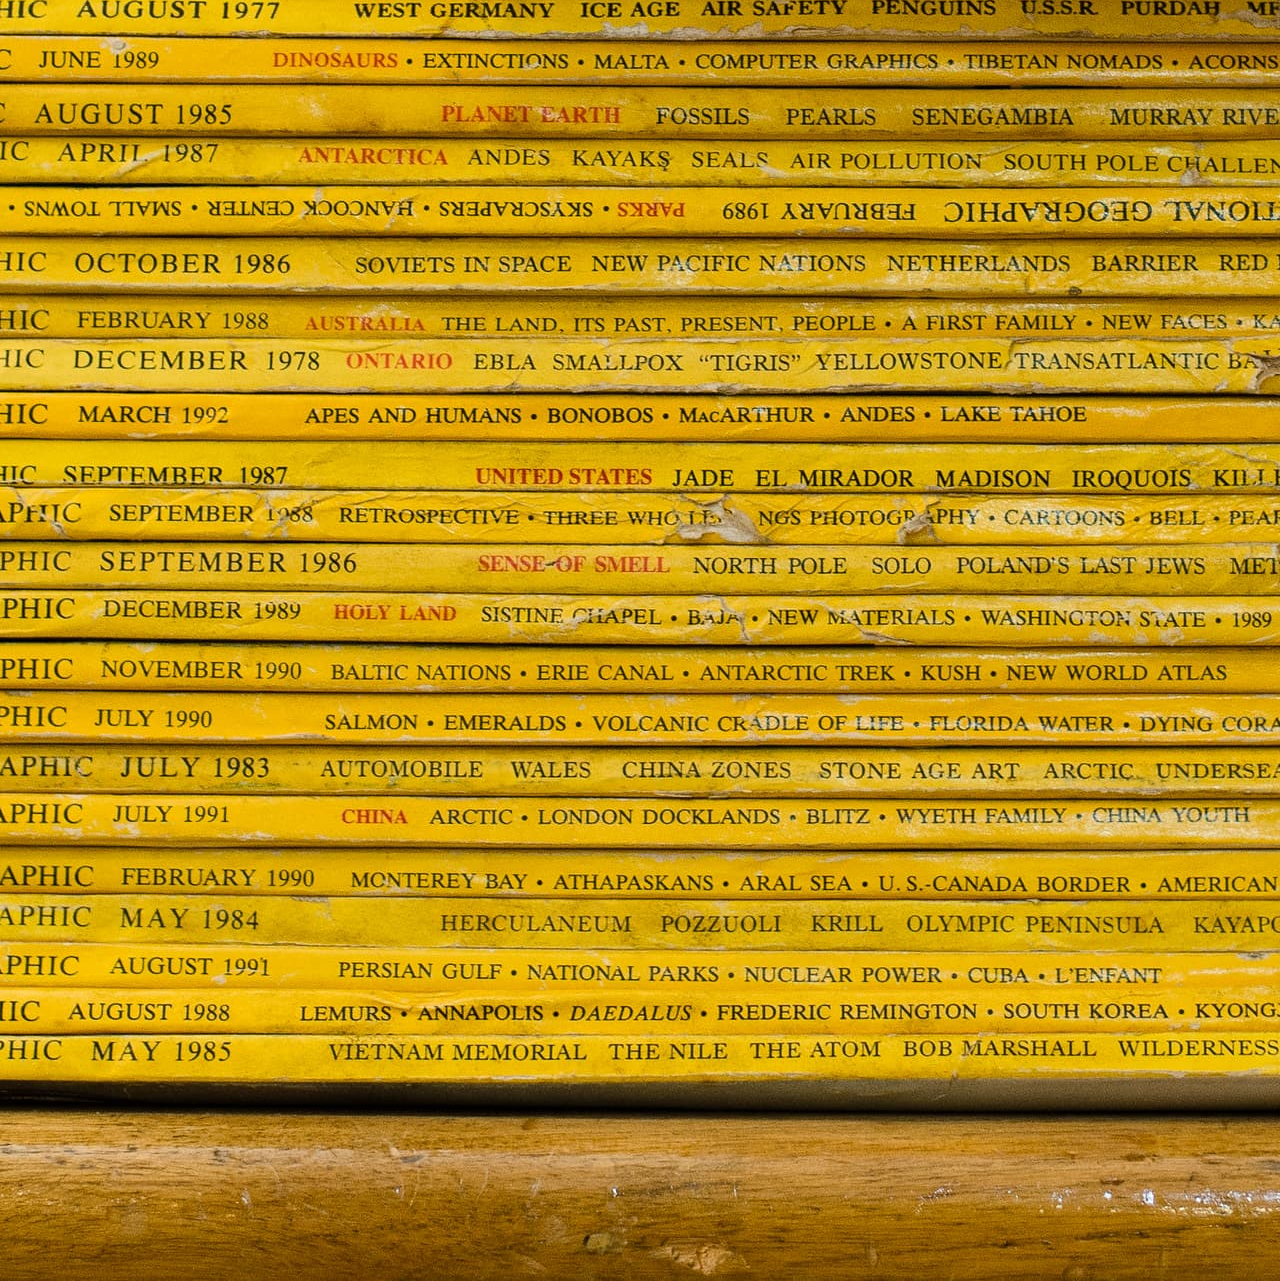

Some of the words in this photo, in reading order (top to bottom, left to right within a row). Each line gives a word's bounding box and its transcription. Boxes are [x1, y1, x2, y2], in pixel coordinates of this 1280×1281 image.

[38, 50, 101, 69] JUNE
[114, 51, 160, 69] 1989
[273, 52, 400, 68] DINOSAURS
[422, 53, 569, 70] EXTINCTIONS
[594, 54, 670, 70] MALTA
[694, 54, 819, 70] COMPUTER
[826, 53, 939, 69] GRAPHICS
[963, 54, 1059, 69] TIBETAN
[1066, 54, 1164, 69] NOMADS
[1188, 54, 1280, 69] ACORNS
[78, 405, 172, 424] MARCH
[182, 406, 229, 424] 1992
[304, 408, 360, 423] APES
[367, 408, 417, 423] AND
[425, 408, 524, 423] HUMANS
[547, 407, 654, 423] BONOBOS
[840, 406, 916, 422] ANDES
[940, 406, 1002, 422] LAKE
[1009, 406, 1088, 422] TAHOE
[101, 660, 243, 679] NOVEMBER
[256, 662, 302, 679] 1990
[331, 664, 409, 681] BALTIC
[416, 664, 512, 681] NATIONS
[536, 664, 590, 681] ERIE
[597, 664, 674, 681] CANAL
[699, 664, 828, 682] ANTARCTIC
[834, 664, 896, 682] TREK
[921, 665, 981, 681] KUSH
[1006, 664, 1057, 681] NEW
[1065, 664, 1149, 681] WORLD
[1156, 664, 1228, 681] ATLAS
[109, 956, 214, 976] AUGUST
[225, 957, 269, 976] 1991
[338, 961, 433, 979] PERSIAN
[441, 963, 503, 980] GULF
[527, 964, 641, 982] NATIONAL
[648, 965, 720, 982] PARKS
[744, 966, 853, 983] NUCLEAR
[861, 967, 943, 984] POWER
[967, 966, 1030, 984] CUBA
[1055, 967, 1163, 984] L'ENFANT
[68, 1003, 173, 1021] AUGUST
[183, 1003, 231, 1021] 1988
[300, 1004, 393, 1021] LEMURS
[416, 1004, 545, 1021] ANNAPOLIS
[569, 1004, 693, 1021] DAEDALUS
[717, 1004, 832, 1021] FREDERIC
[839, 1003, 977, 1020] REMINGTON
[1003, 1003, 1080, 1020] SOUTH
[1088, 1003, 1169, 1020] KOREA
